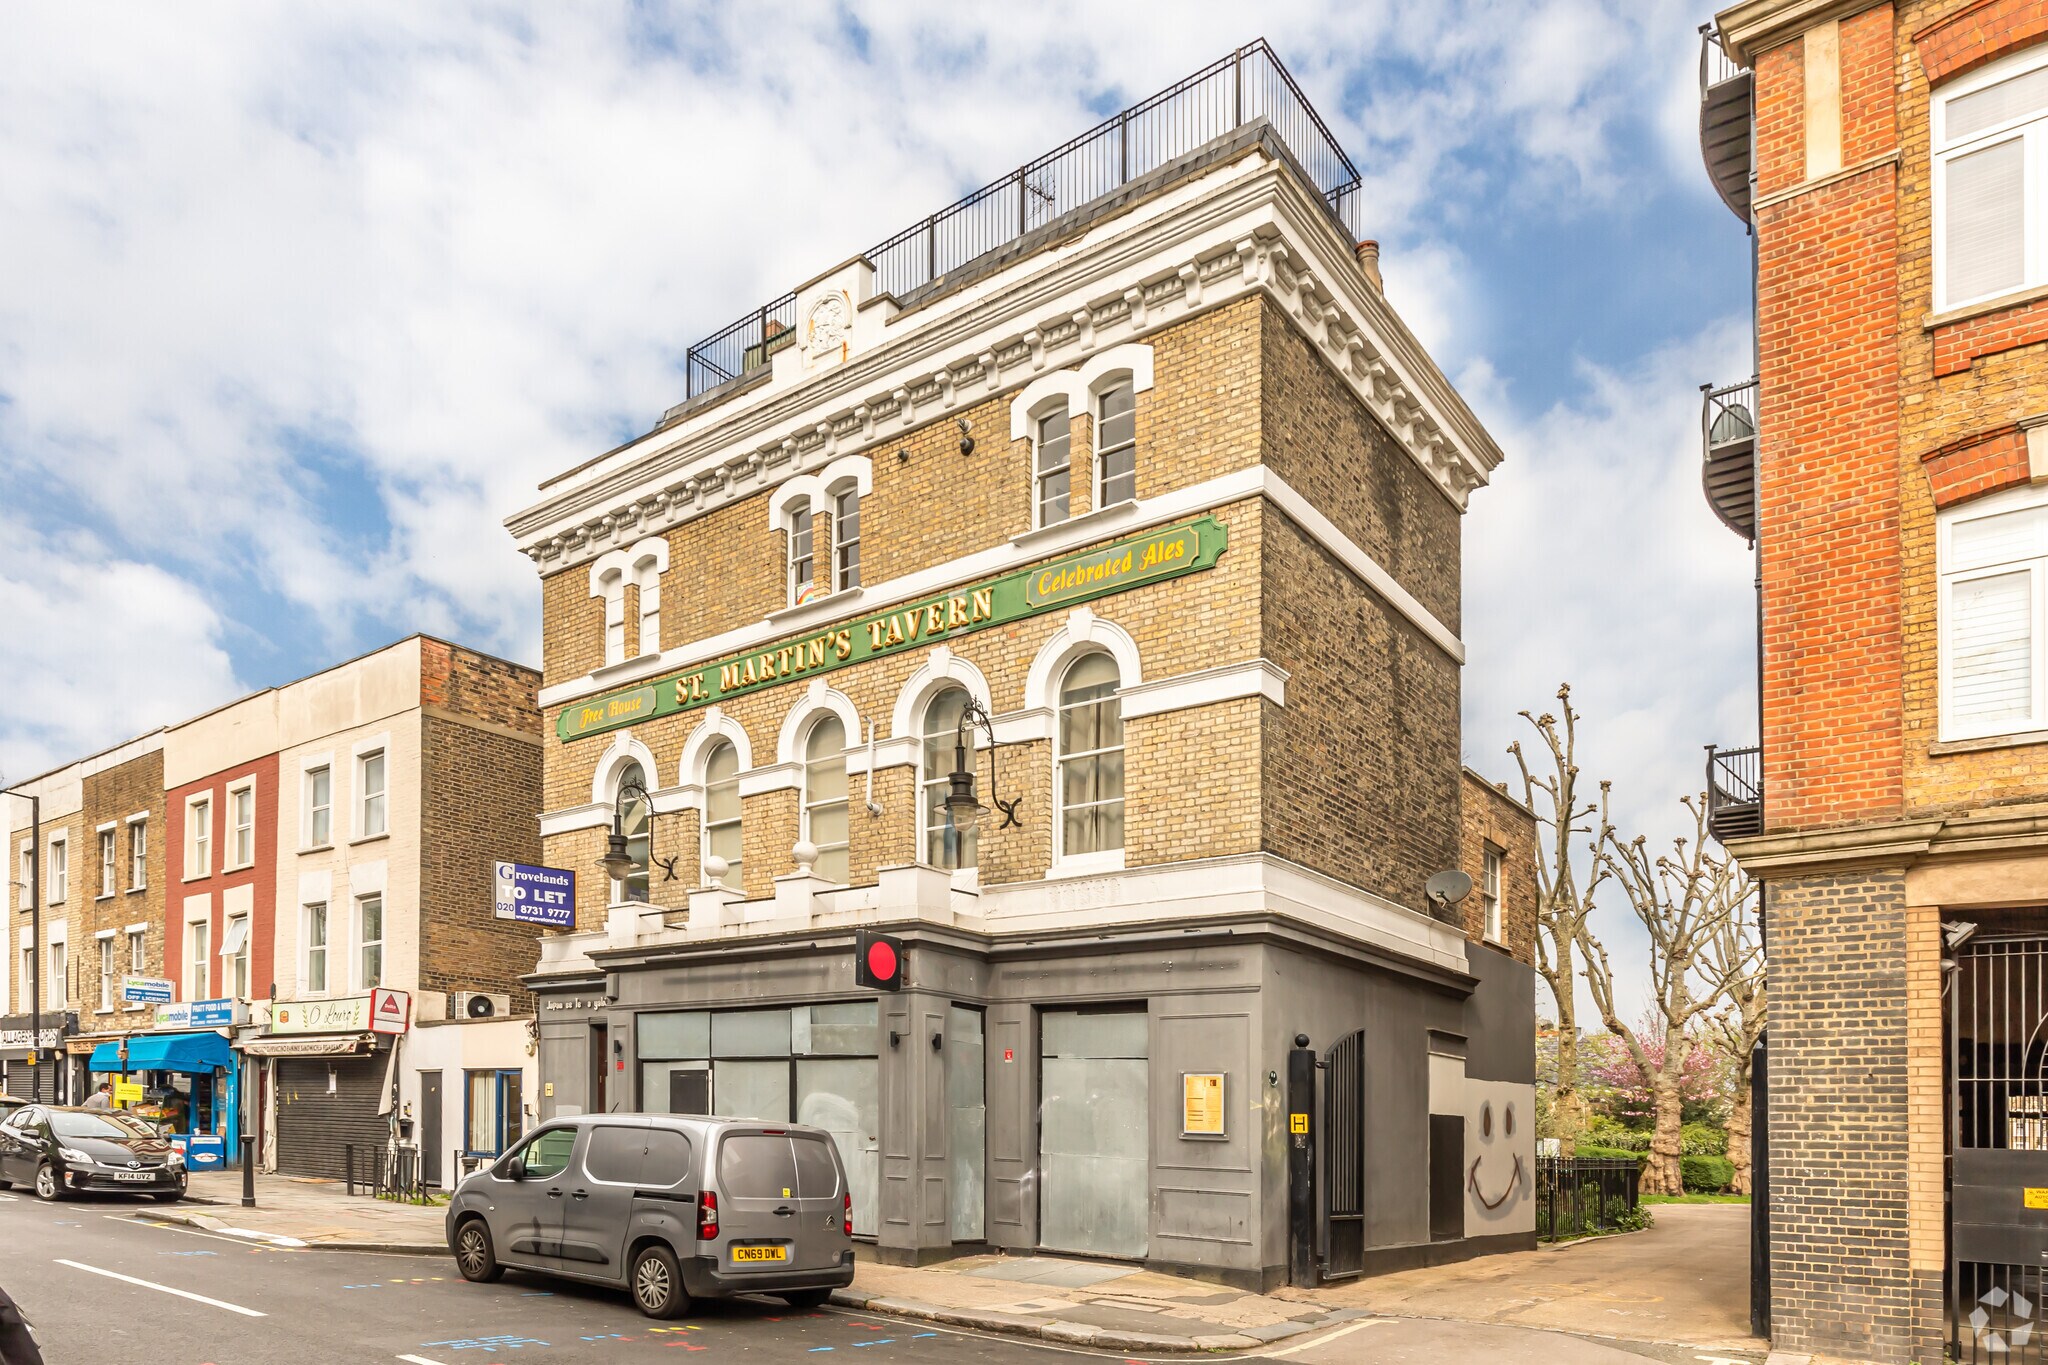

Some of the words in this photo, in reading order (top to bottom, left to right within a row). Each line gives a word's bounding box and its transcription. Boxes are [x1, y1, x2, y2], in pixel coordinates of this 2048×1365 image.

[1038, 550, 1132, 596] Celebrated
[1139, 539, 1185, 572] Ales
[675, 673, 709, 704] ST.
[719, 629, 851, 692] MARTIN'S
[866, 587, 994, 650] TAVERN
[579, 708, 603, 729] Free
[608, 697, 641, 717] House
[499, 865, 569, 886] Grovelands
[502, 885, 526, 899] TO
[534, 889, 566, 904] LET
[497, 902, 514, 912] 020
[520, 905, 543, 915] 8731
[547, 908, 570, 918] 9777
[127, 979, 170, 989] Lycamobile
[155, 1009, 188, 1024] Lycamobile
[1293, 1116, 1306, 1131] H
[738, 1249, 762, 1259] CN69
[765, 1249, 781, 1258] DWL
